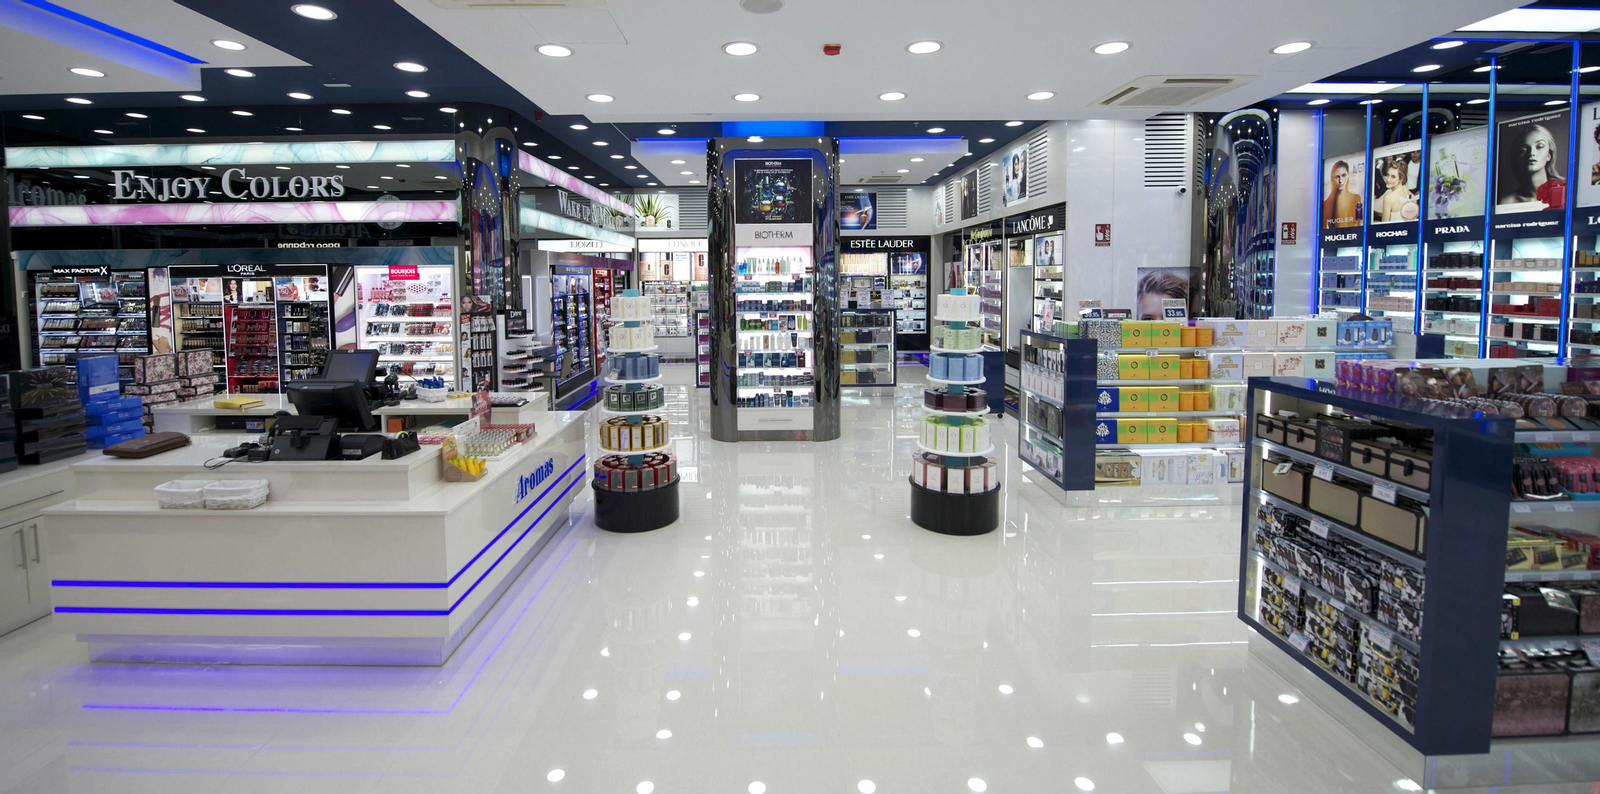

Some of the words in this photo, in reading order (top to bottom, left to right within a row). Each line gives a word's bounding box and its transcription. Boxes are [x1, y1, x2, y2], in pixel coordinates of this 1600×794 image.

[1508, 119, 1531, 128] narciso
[112, 169, 211, 201] ENJOY
[221, 167, 345, 200] COLORS
[557, 188, 581, 219] WAKE
[1013, 215, 1046, 234] LANCÔME
[1326, 216, 1354, 225] MUGLER
[1522, 220, 1559, 228] rodriguez
[1376, 230, 1409, 239] ROCHAS
[1435, 225, 1470, 235] PRADA
[754, 231, 792, 239] BIOTHERM
[1324, 233, 1358, 242] MUGLER
[850, 239, 876, 249] ESTÉE
[878, 239, 914, 249] LAUDER
[514, 457, 554, 505] Aromas
